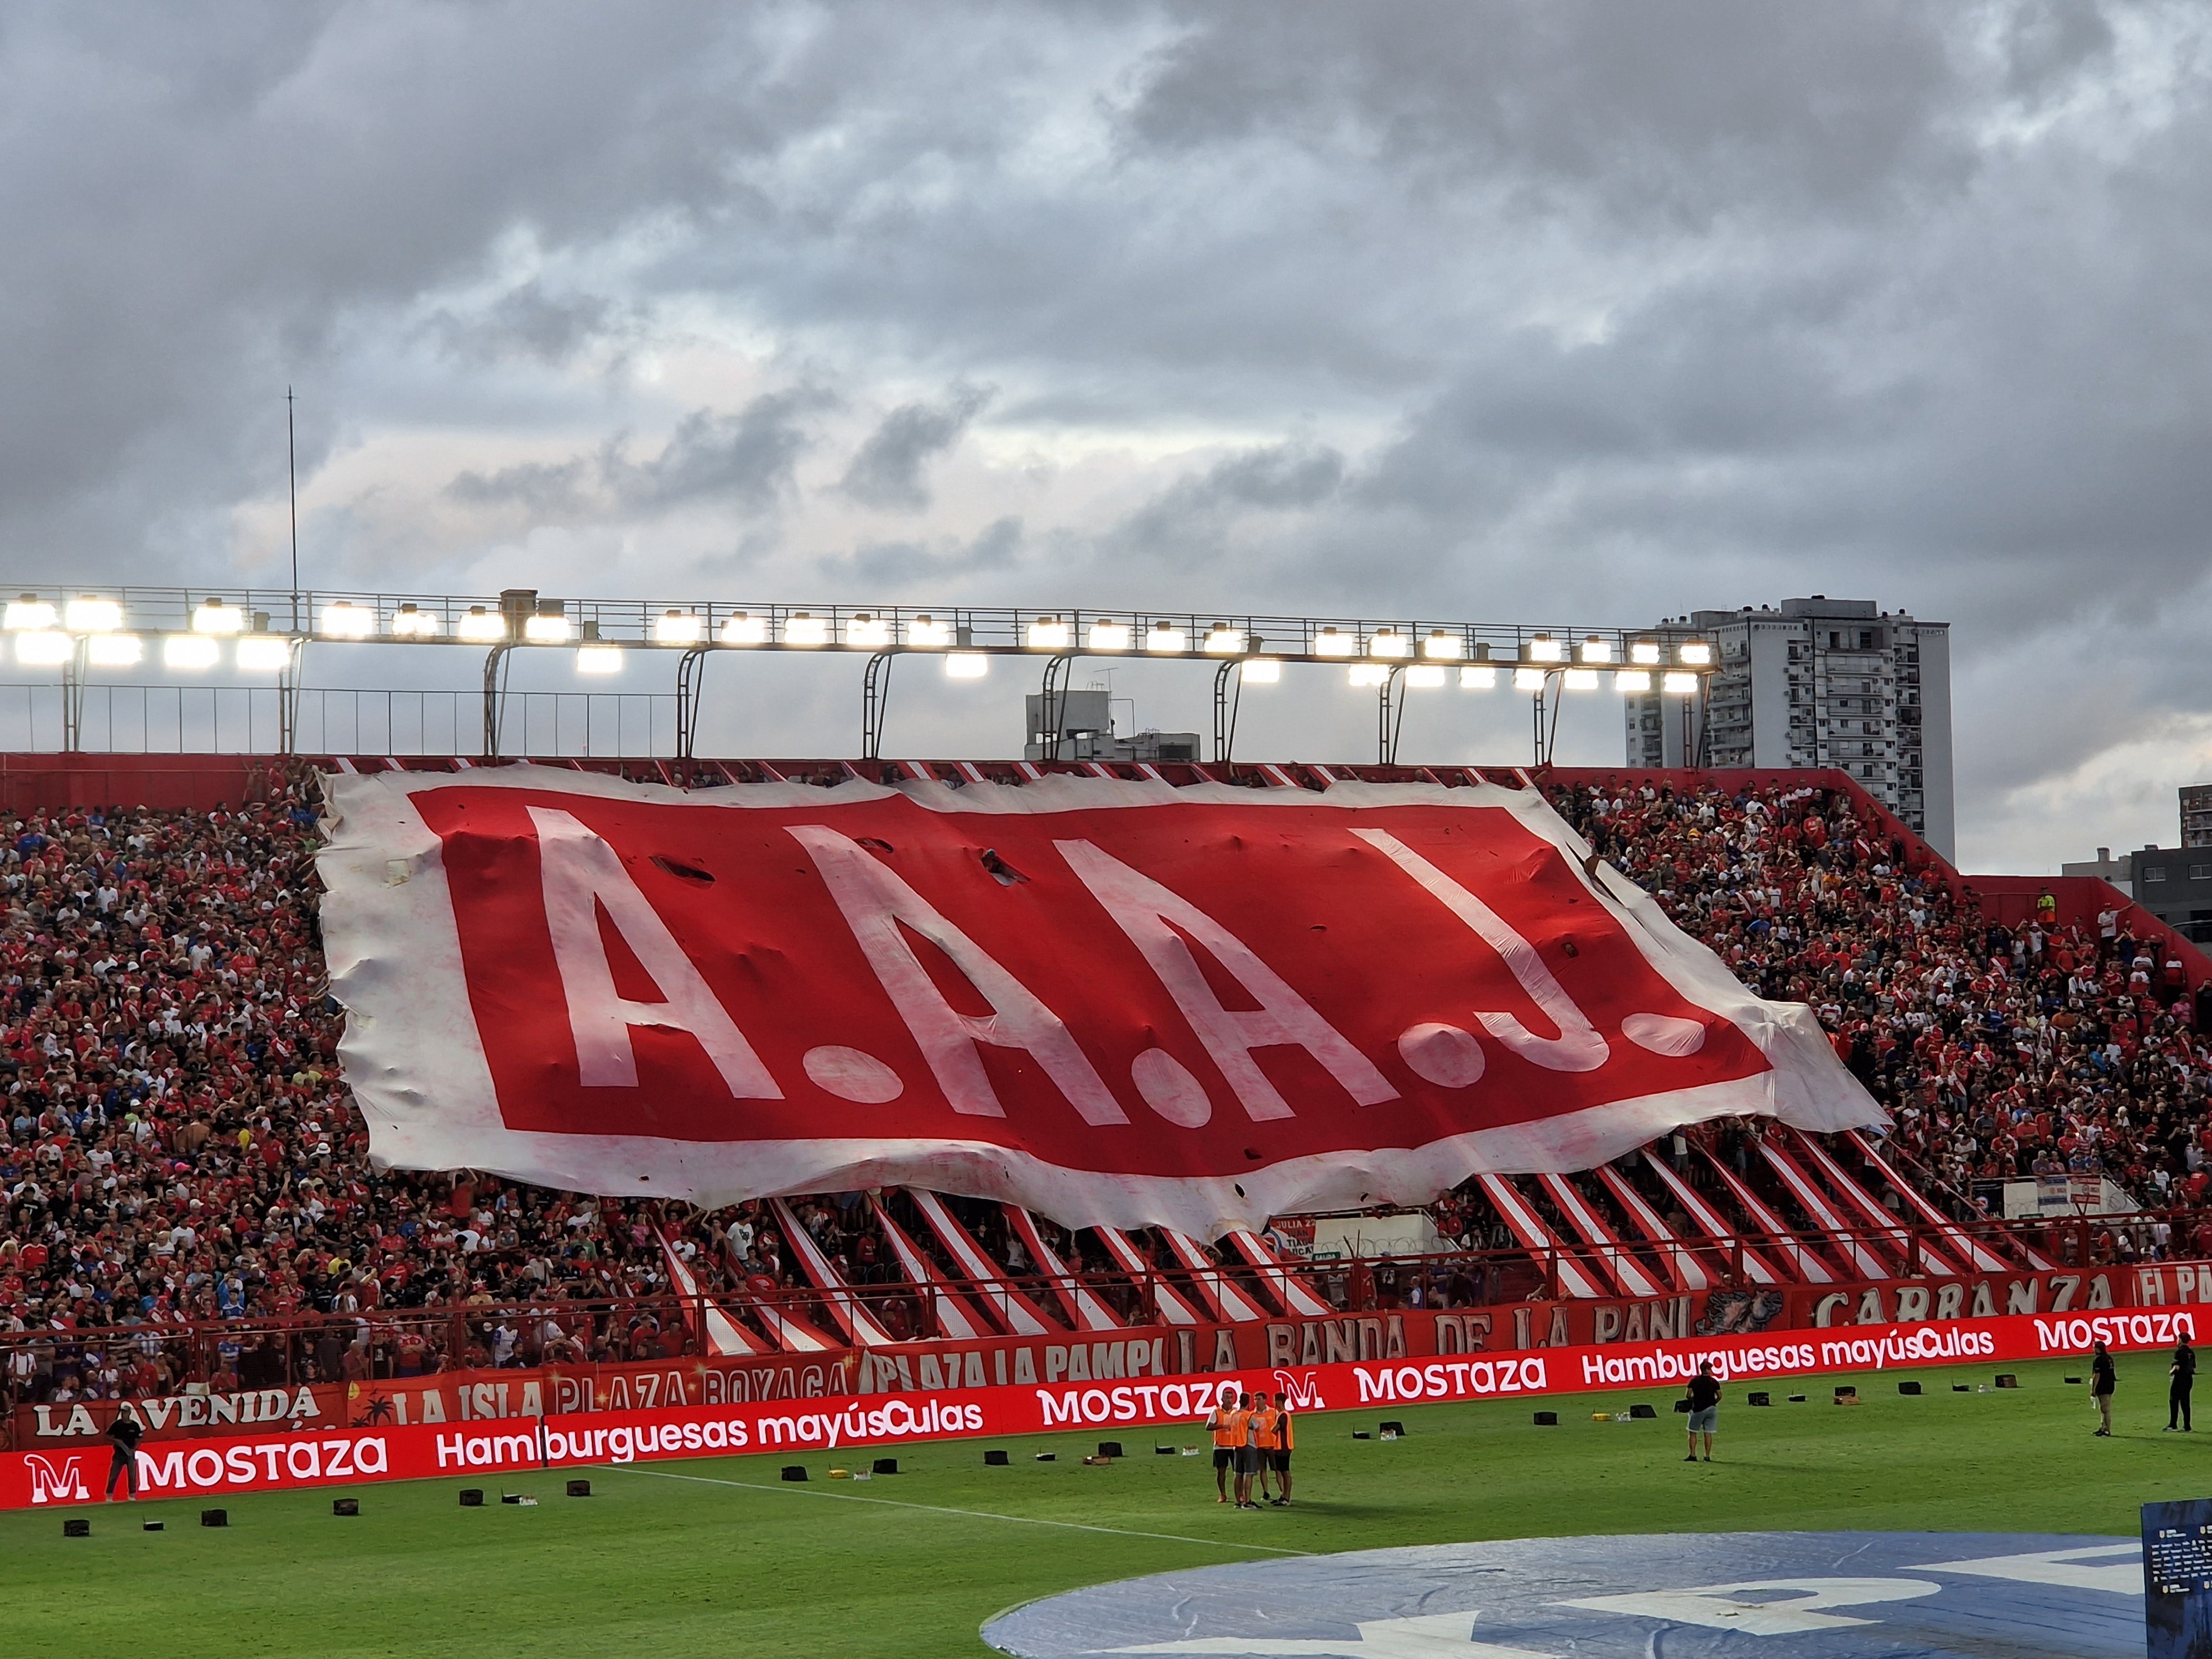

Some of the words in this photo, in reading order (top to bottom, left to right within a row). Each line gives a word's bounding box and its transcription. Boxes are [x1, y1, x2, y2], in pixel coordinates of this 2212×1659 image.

[525, 805, 1705, 1129] A.A.A.J.
[1276, 1220, 1302, 1229] JULIA
[1815, 1273, 2115, 1328] CARRANZA
[1177, 1329, 1238, 1375] LA
[1266, 1314, 1407, 1369] BANDA
[1512, 1306, 1569, 1351] LA
[33, 1404, 100, 1436] LA
[117, 1386, 321, 1431] AVENIDA
[392, 1389, 447, 1425] LA
[458, 1381, 544, 1421] ISLA
[436, 1420, 748, 1468] Hamburguesas
[1582, 1343, 1815, 1385] Hamburguesas
[554, 1371, 687, 1415] PLAZA
